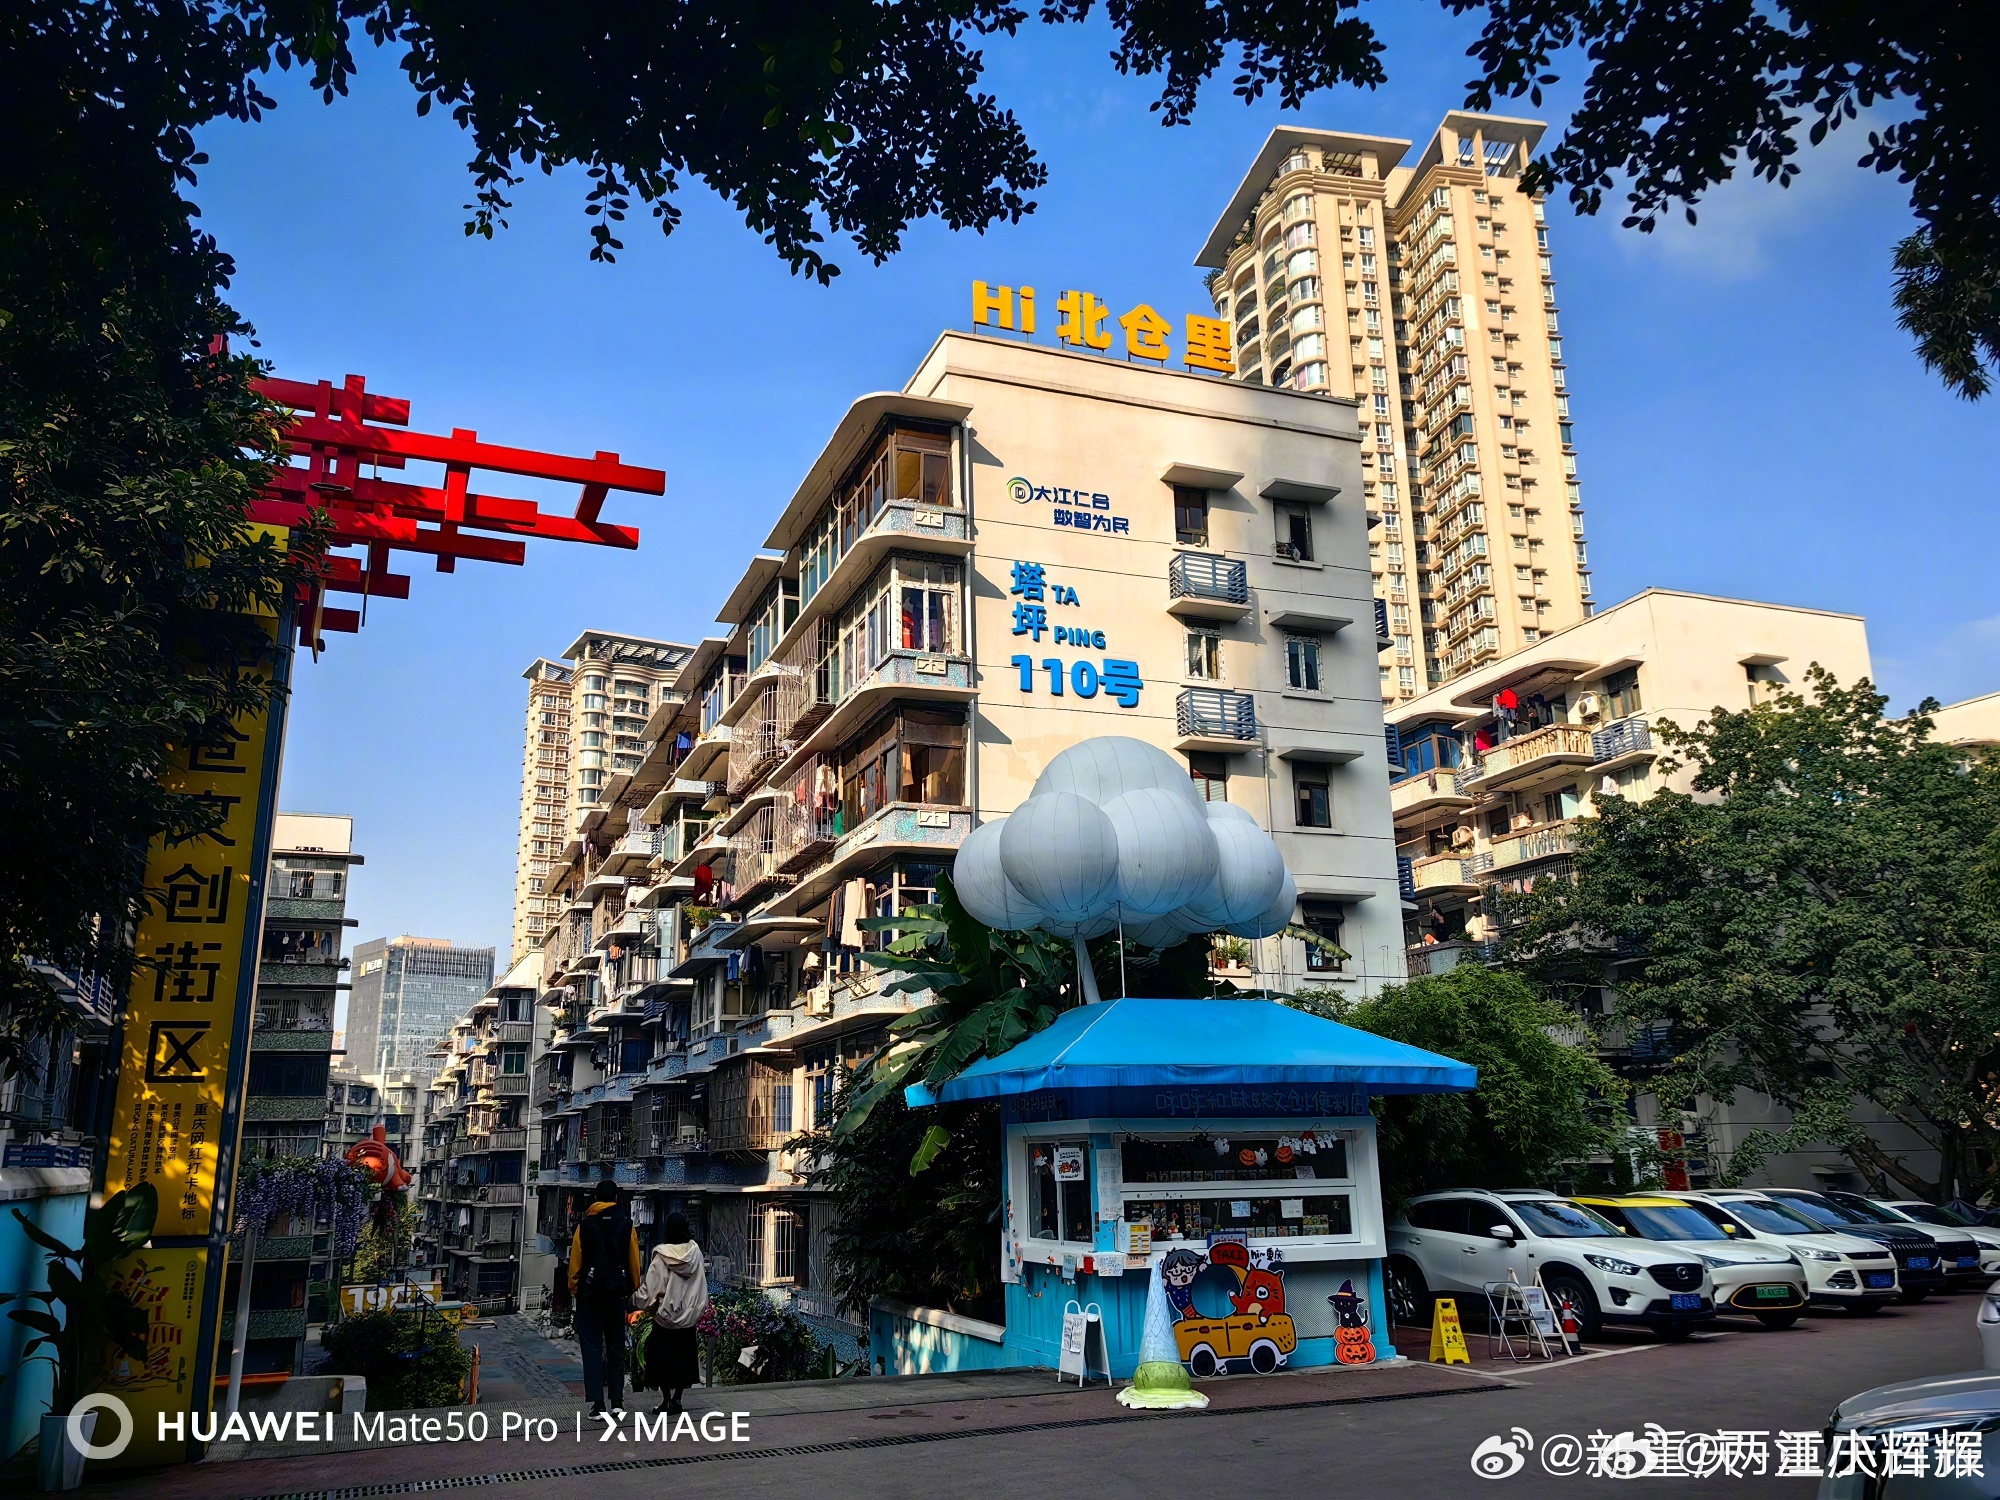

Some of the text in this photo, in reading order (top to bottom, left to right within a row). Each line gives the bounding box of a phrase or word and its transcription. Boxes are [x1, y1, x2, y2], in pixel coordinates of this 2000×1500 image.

[972, 280, 1236, 373] Hi 北仓里
[1033, 485, 1110, 510] 大江仁合
[1053, 508, 1130, 534] 数智为民
[1051, 585, 1080, 607] TA
[1053, 625, 1106, 650] PING
[1011, 654, 1143, 708] 110号
[181, 1103, 209, 1221] 重庆网红打卡地标
